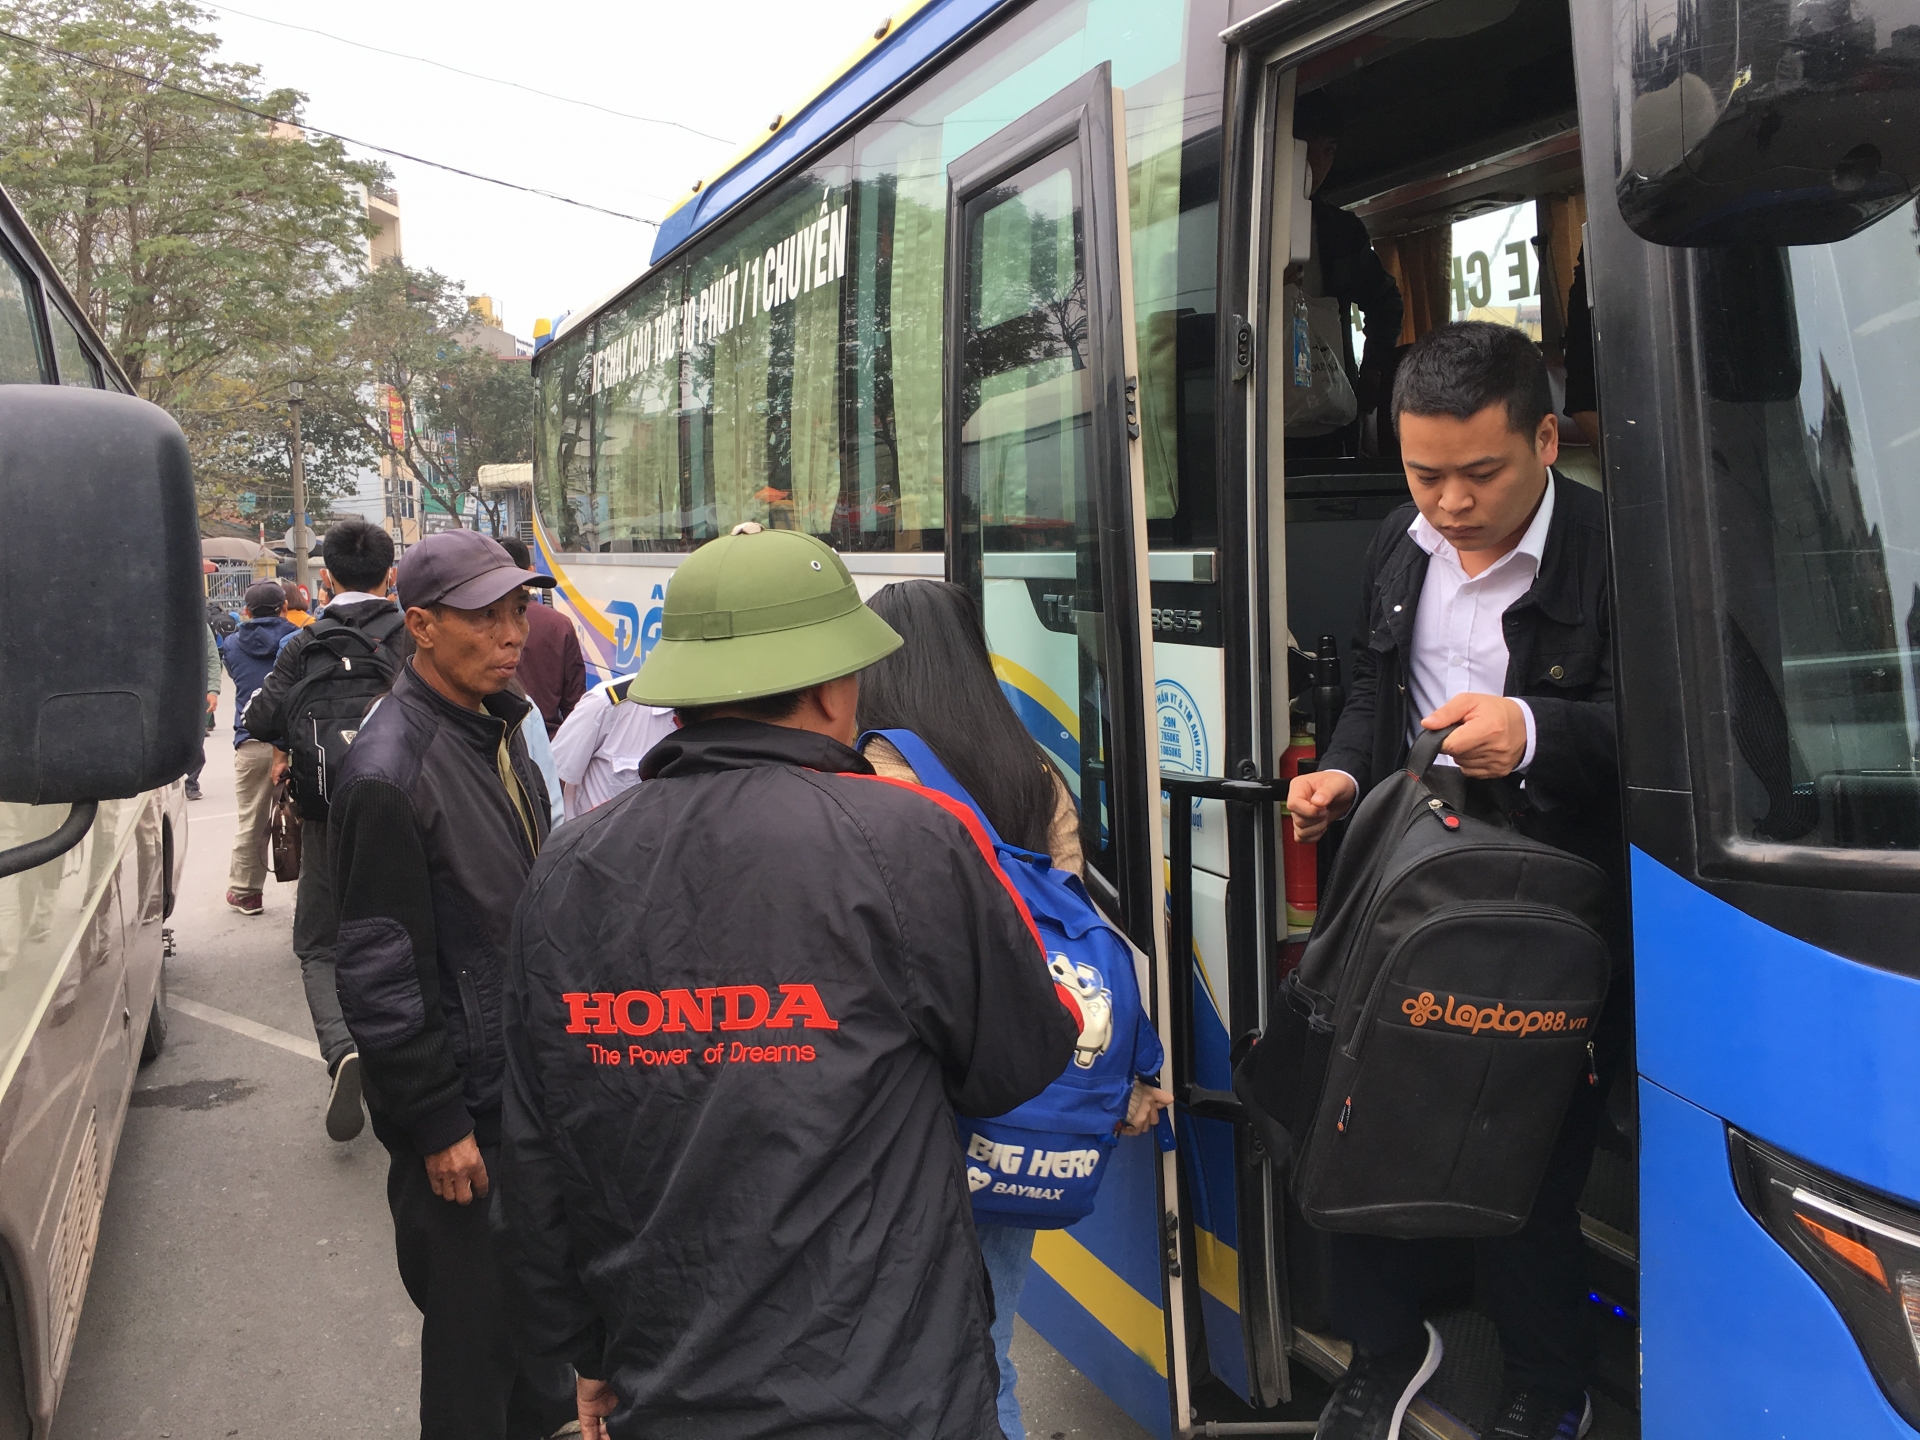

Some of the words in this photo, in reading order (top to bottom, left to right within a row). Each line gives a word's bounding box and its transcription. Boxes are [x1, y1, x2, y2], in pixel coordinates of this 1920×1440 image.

[630, 322, 651, 377] CAO
[654, 289, 677, 365] TỐC
[680, 296, 696, 353] 30
[699, 264, 738, 345] PHÚT
[763, 186, 848, 312] CHUYẾN
[1190, 723, 1201, 747] ANH
[562, 984, 839, 1036] HONDA
[586, 1044, 621, 1065] The
[629, 1045, 692, 1066] Power
[703, 1042, 725, 1064] of
[729, 1041, 816, 1063] Dreams
[967, 1132, 1025, 1174] BIG
[1027, 1149, 1100, 1178] HERO
[992, 1182, 1065, 1200] BAYMAX
